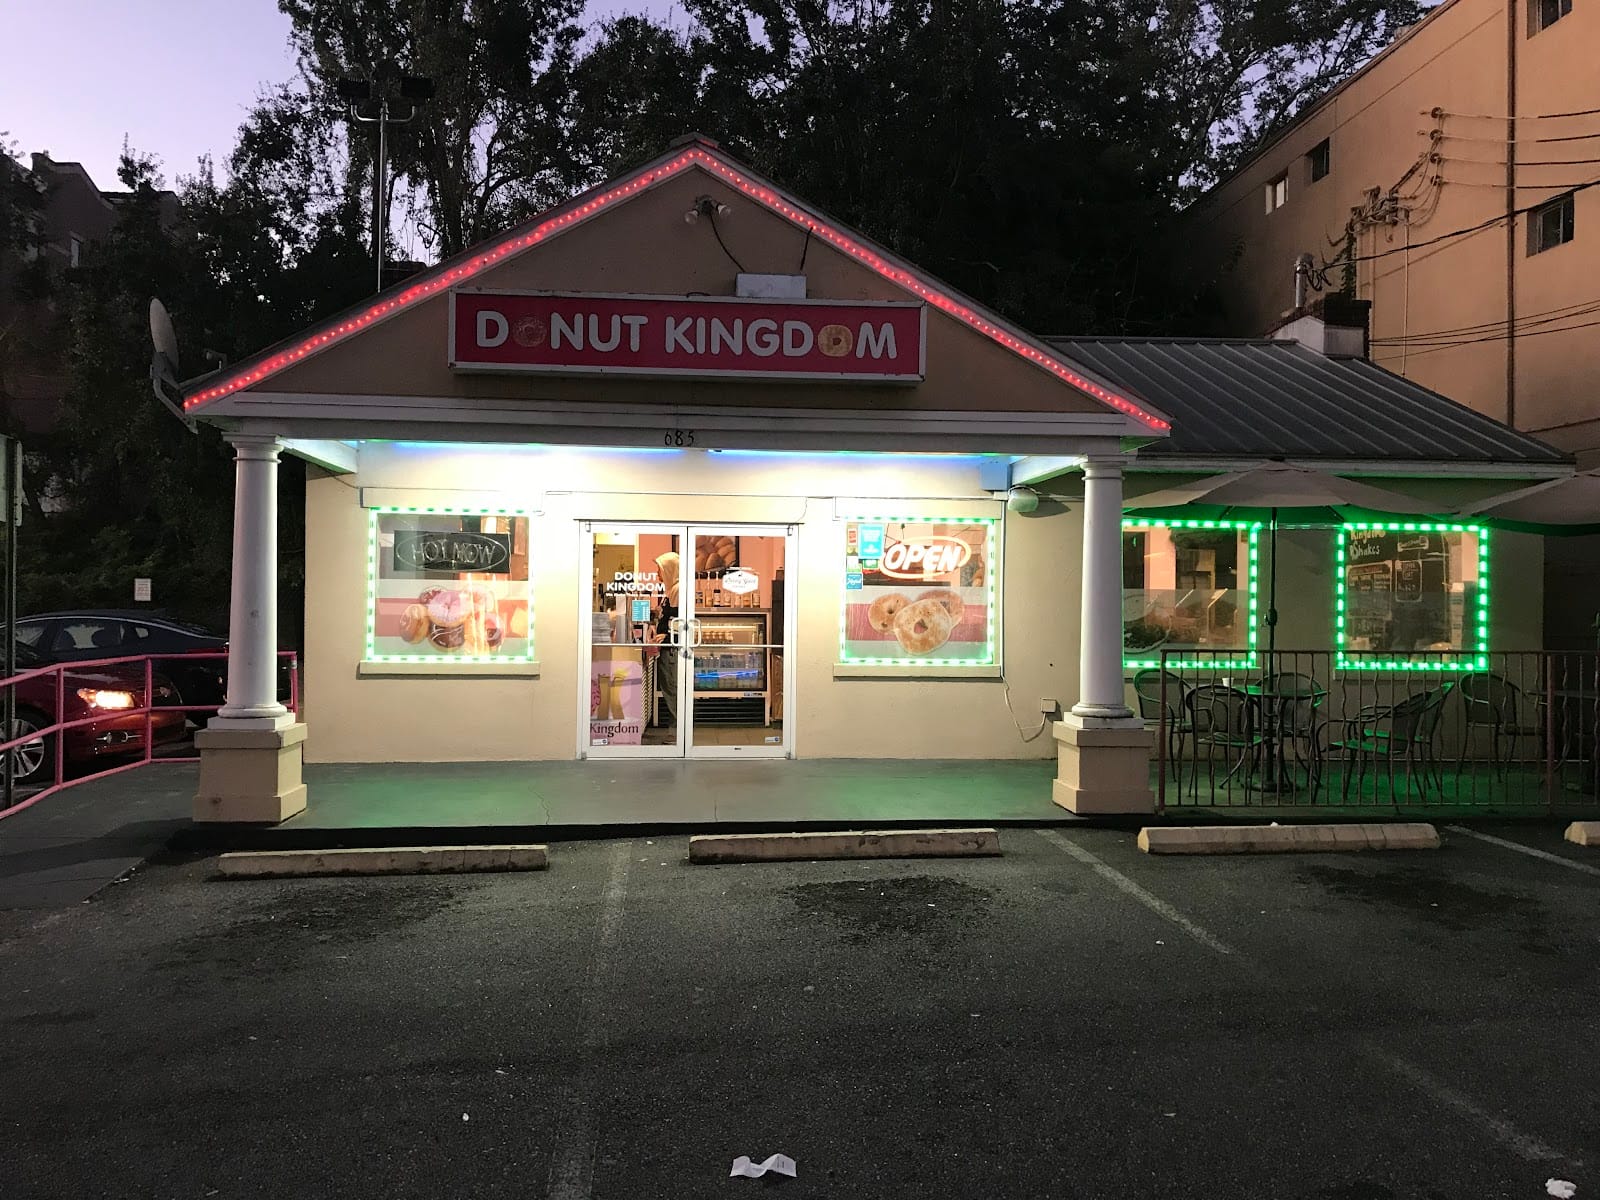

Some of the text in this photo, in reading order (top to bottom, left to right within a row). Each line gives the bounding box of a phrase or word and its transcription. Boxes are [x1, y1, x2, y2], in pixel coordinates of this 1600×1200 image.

[476, 310, 898, 359] DONUT KINGDOM
[664, 429, 695, 447] 685
[453, 541, 496, 564] NOW
[884, 544, 961, 571] OPEN
[614, 572, 658, 581] DONUT
[606, 582, 666, 592] KINGDOM
[590, 721, 639, 738] Kingdom
